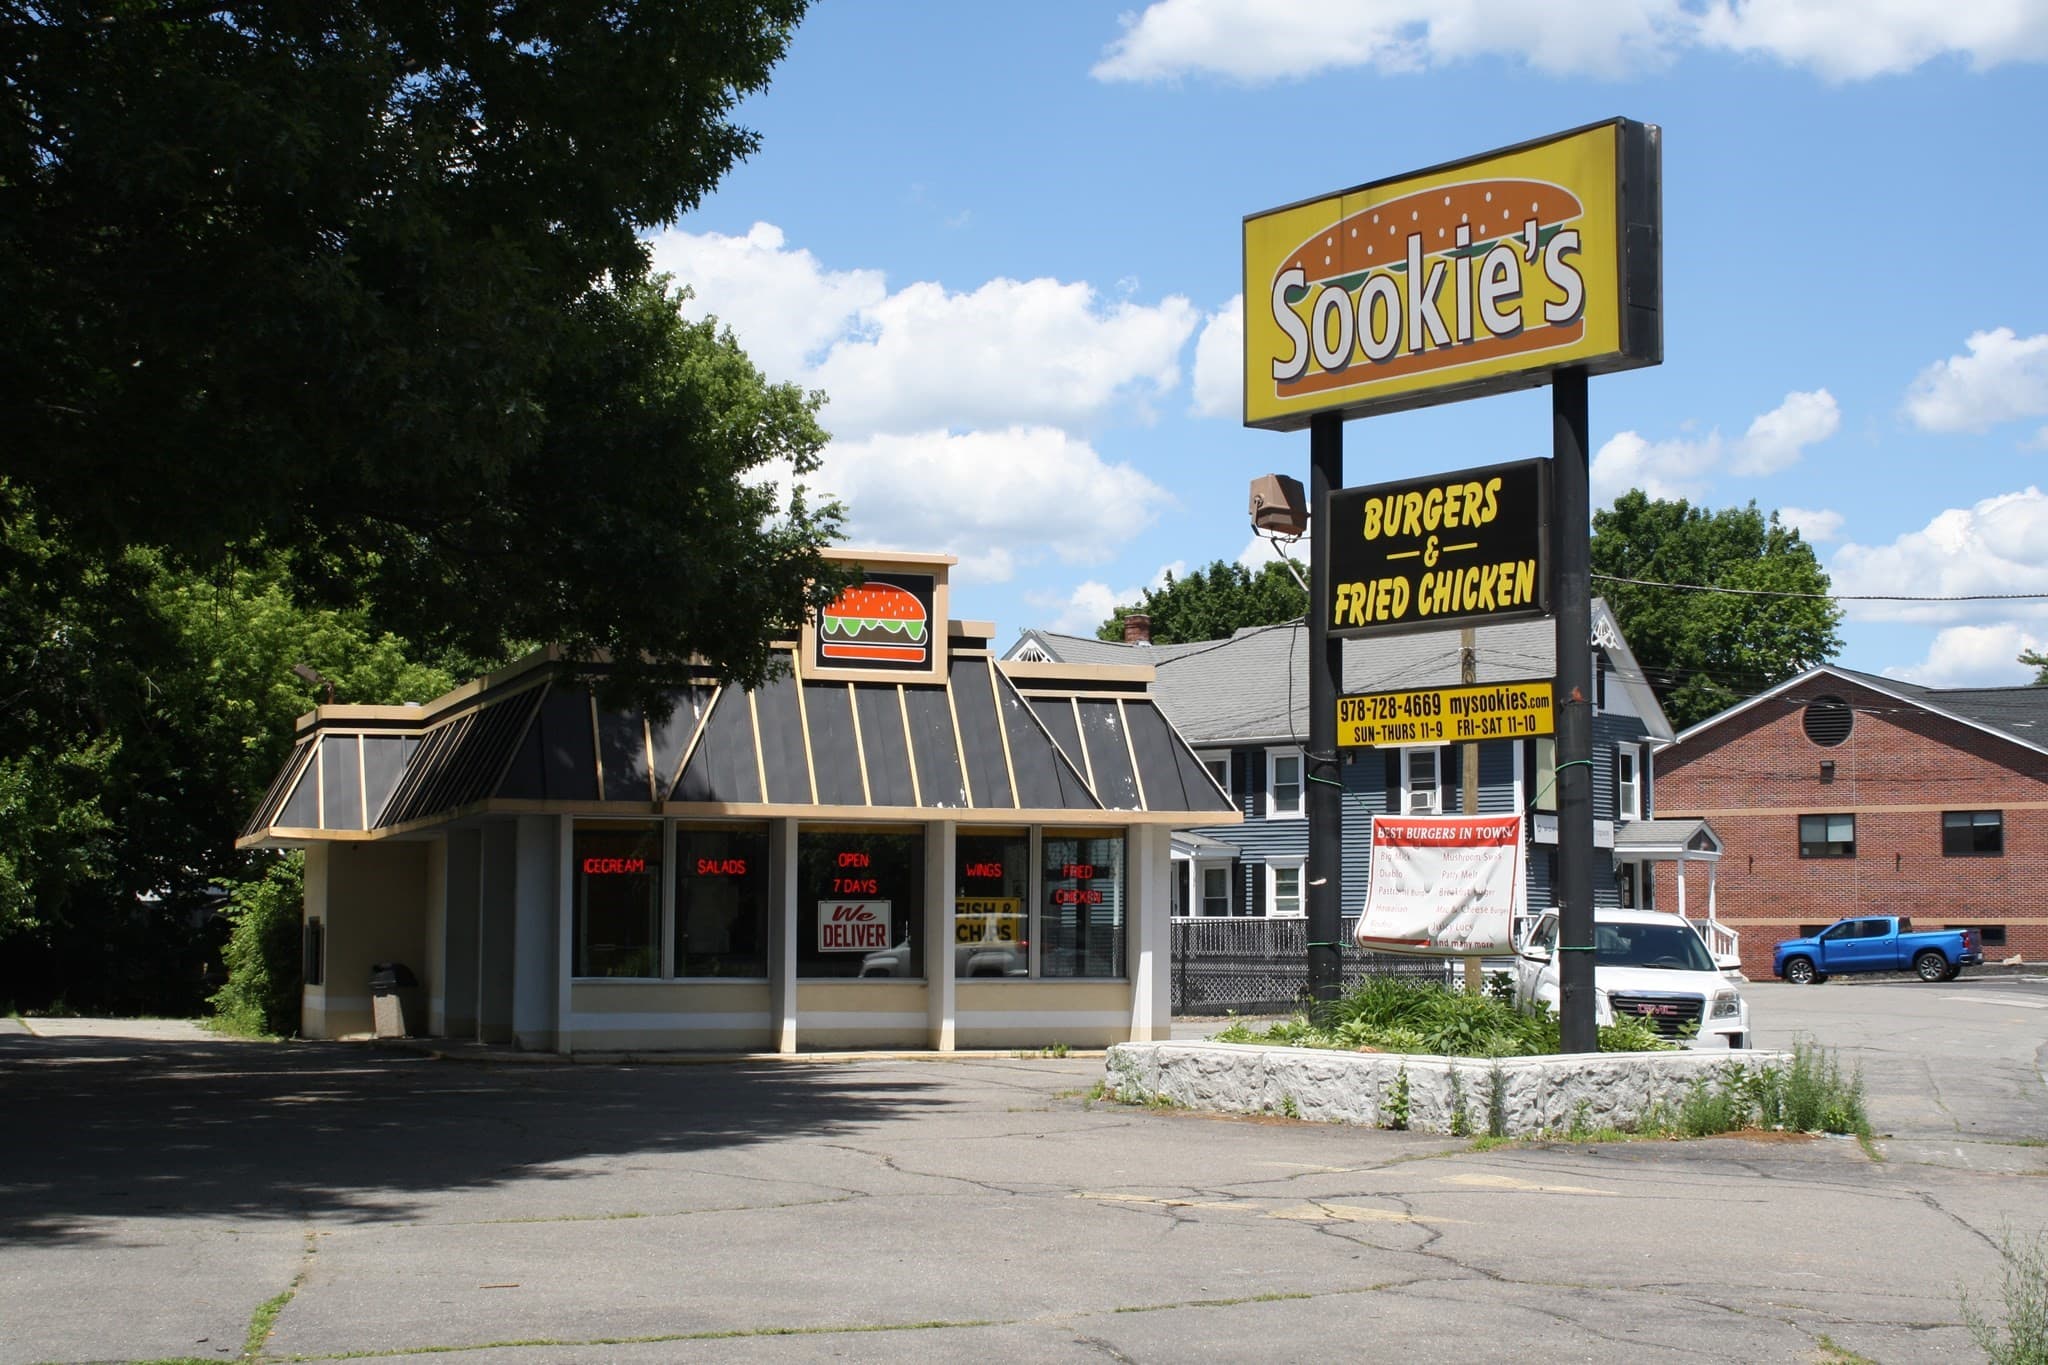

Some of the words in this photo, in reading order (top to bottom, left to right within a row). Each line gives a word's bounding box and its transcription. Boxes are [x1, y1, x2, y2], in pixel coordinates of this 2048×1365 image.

[1272, 218, 1586, 381] Sookie's
[1363, 478, 1501, 541] BURGERS
[1424, 536, 1438, 566] &
[1335, 576, 1410, 627] FRIED
[1418, 559, 1535, 616] CHICKEN
[1341, 693, 1441, 722] 978-728-4669
[1450, 688, 1549, 717] mysookies.com
[1354, 723, 1416, 742] SUN-THURS
[1421, 721, 1443, 738] 11-9
[1457, 717, 1502, 736] FRI-SAT
[1508, 714, 1536, 732] 11-10
[1377, 826, 1403, 839] BEST
[1406, 827, 1456, 839] BURGERS
[1459, 827, 1472, 839] IN
[697, 858, 746, 875] SALADS
[838, 853, 869, 868] OPEN
[966, 863, 1002, 878] WINGS
[1063, 864, 1094, 879] FRIED
[833, 879, 841, 894] 7
[844, 879, 878, 894] DAYS
[1055, 888, 1103, 904] CHICKEN
[832, 904, 877, 921] We
[955, 902, 996, 920] FISH
[823, 924, 886, 947] DELIVER
